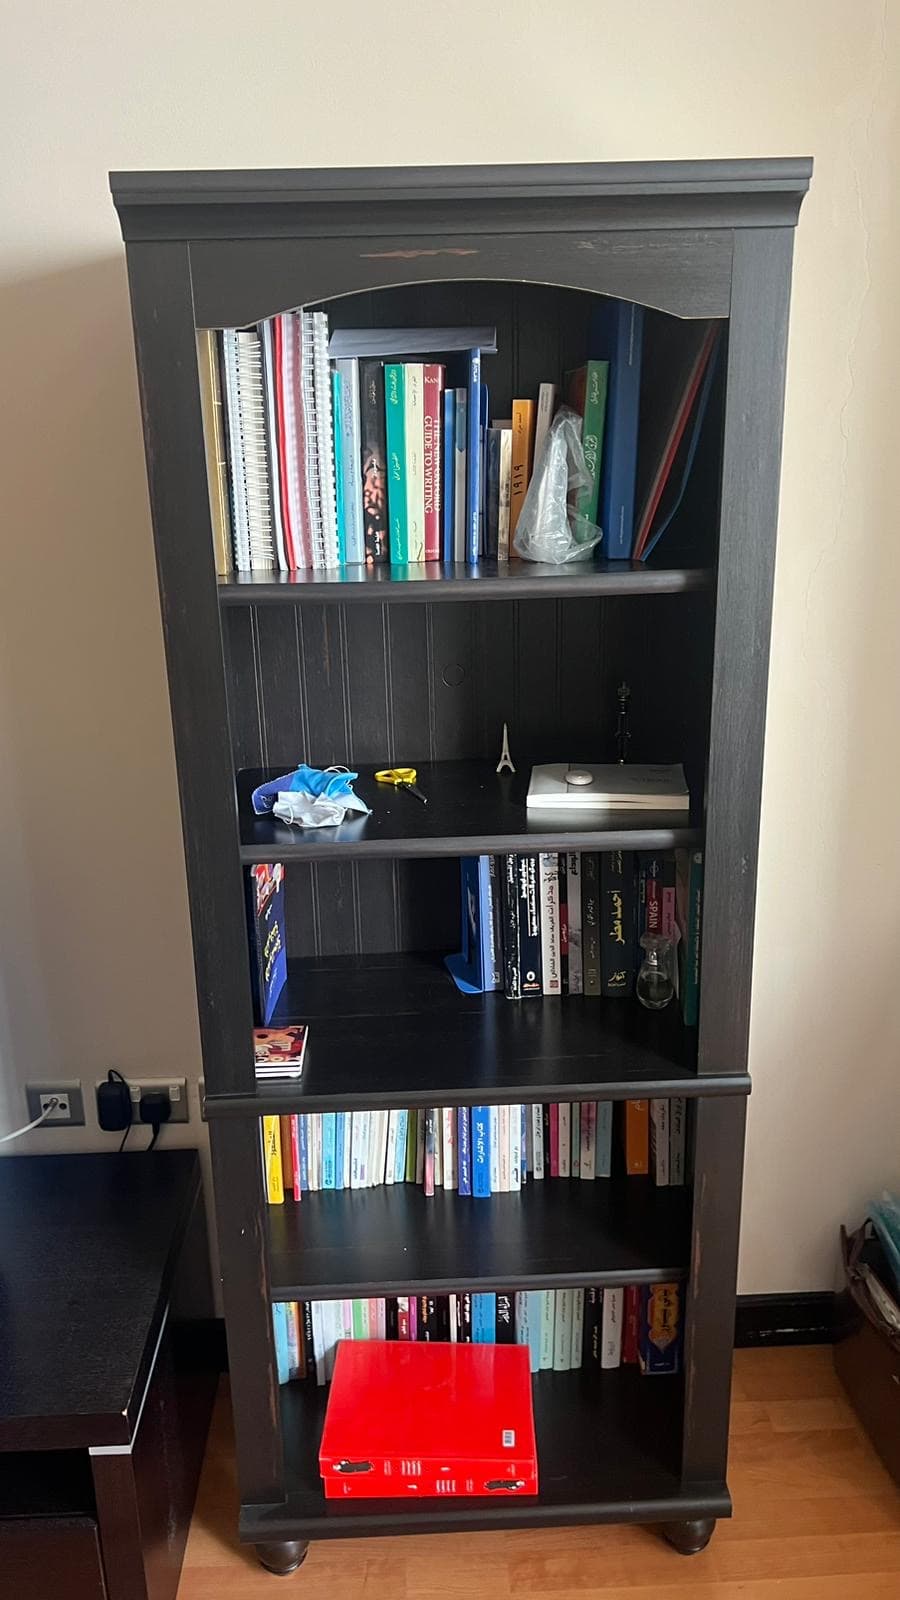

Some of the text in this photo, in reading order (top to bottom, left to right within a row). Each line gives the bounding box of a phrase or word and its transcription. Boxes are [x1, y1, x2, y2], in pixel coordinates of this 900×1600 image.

[424, 415, 433, 514] GUIDE TO WRITING
[512, 464, 524, 496] ١٩١٩
[545, 885, 555, 915] مذكرات
[607, 890, 622, 920] أحمد
[648, 900, 659, 929] SPAIN
[609, 920, 625, 946] مطر
[475, 1122, 486, 1137] كتاب
